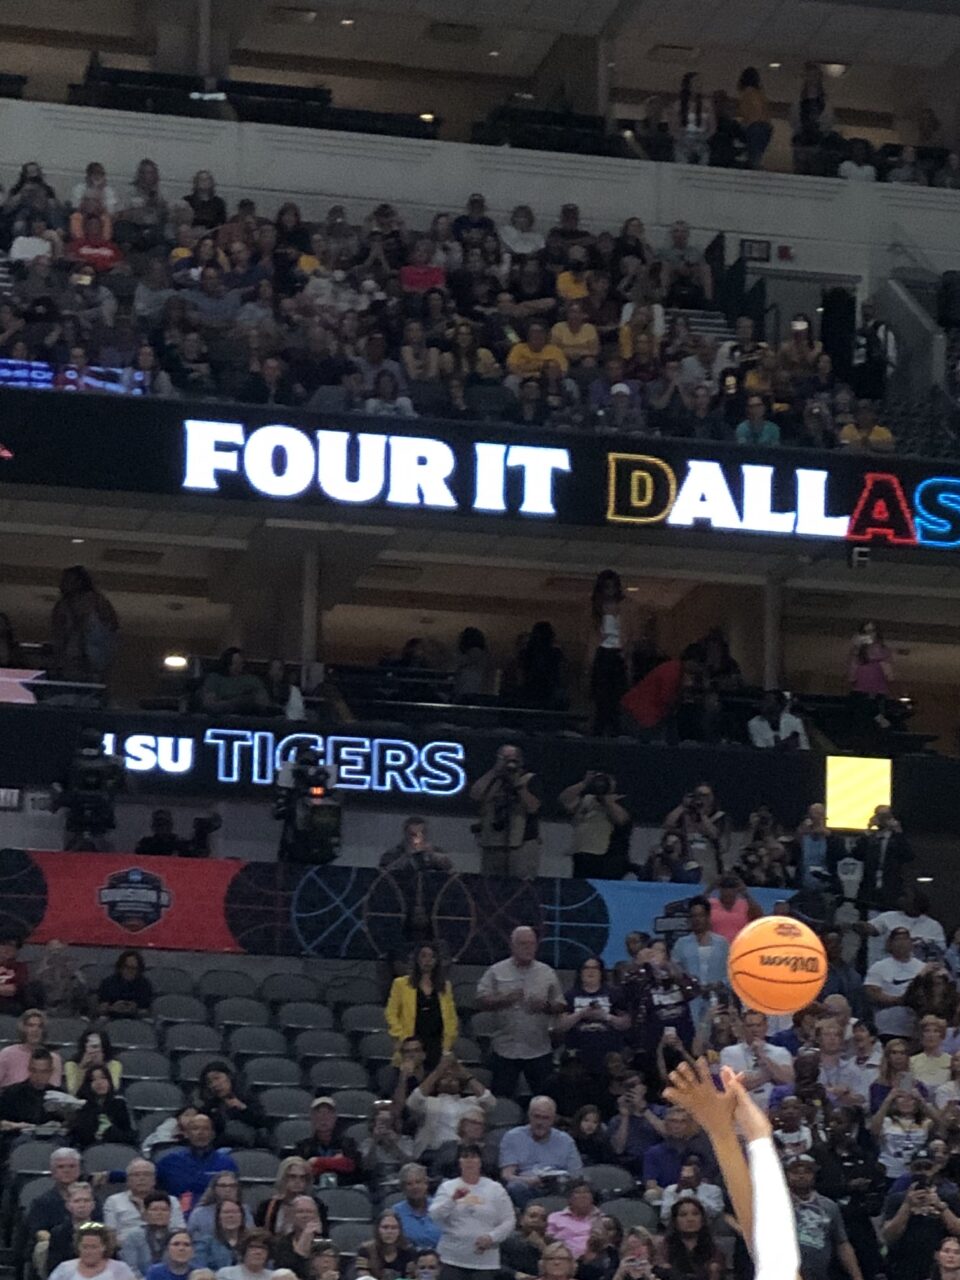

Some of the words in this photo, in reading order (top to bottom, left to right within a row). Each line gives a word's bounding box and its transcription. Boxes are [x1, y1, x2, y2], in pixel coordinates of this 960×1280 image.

[182, 419, 458, 508] FOUR
[473, 442, 571, 514] IT
[102, 734, 193, 773] SU
[760, 955, 819, 973] Wilson
